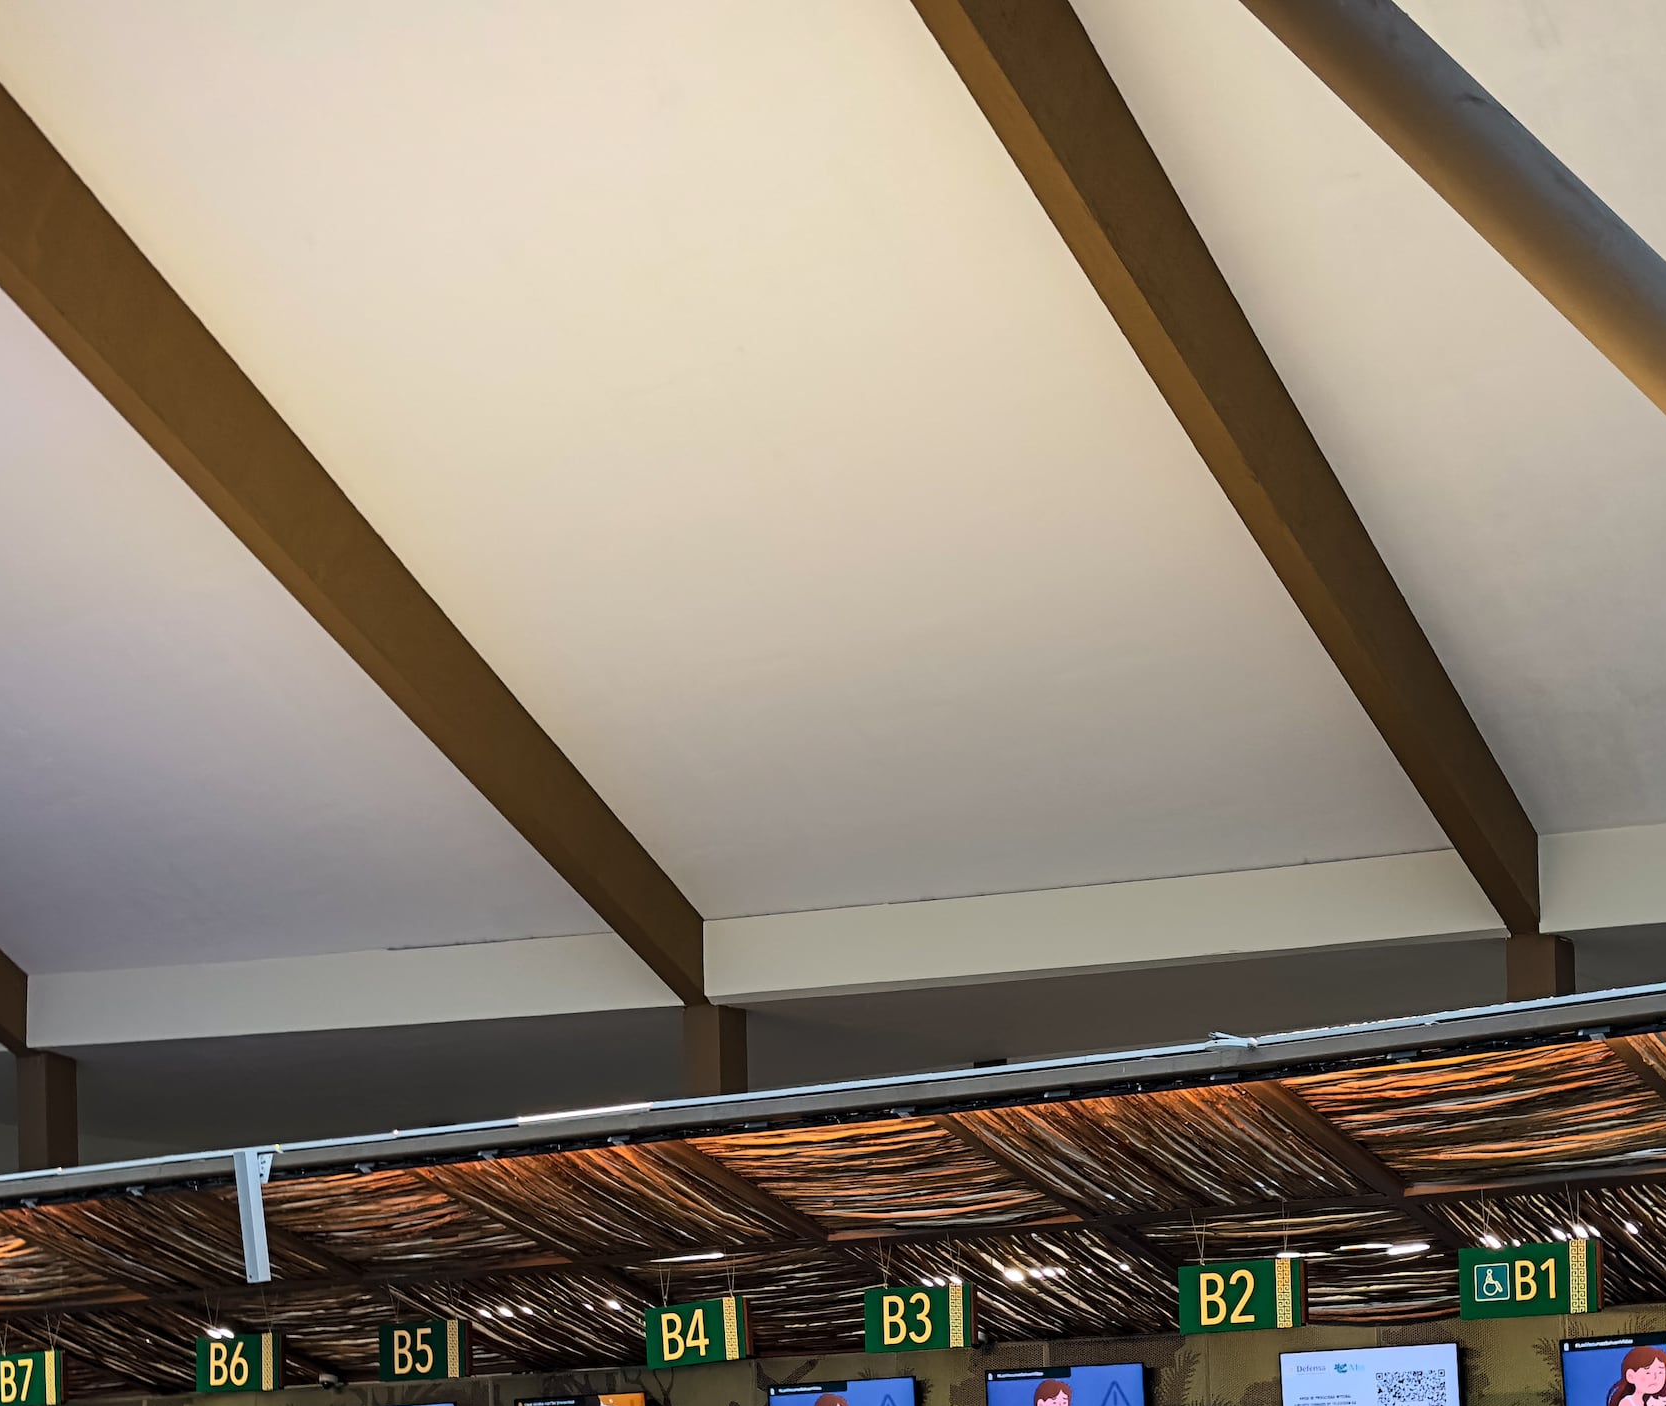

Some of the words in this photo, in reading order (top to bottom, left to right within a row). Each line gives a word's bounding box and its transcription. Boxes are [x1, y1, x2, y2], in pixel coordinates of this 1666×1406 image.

[1199, 1269, 1255, 1326] B2
[1514, 1258, 1557, 1302] B1
[660, 1308, 710, 1361] B4
[882, 1292, 933, 1345] B3
[209, 1341, 249, 1386] B6
[393, 1327, 434, 1375] B5
[0, 1358, 34, 1403] B7
